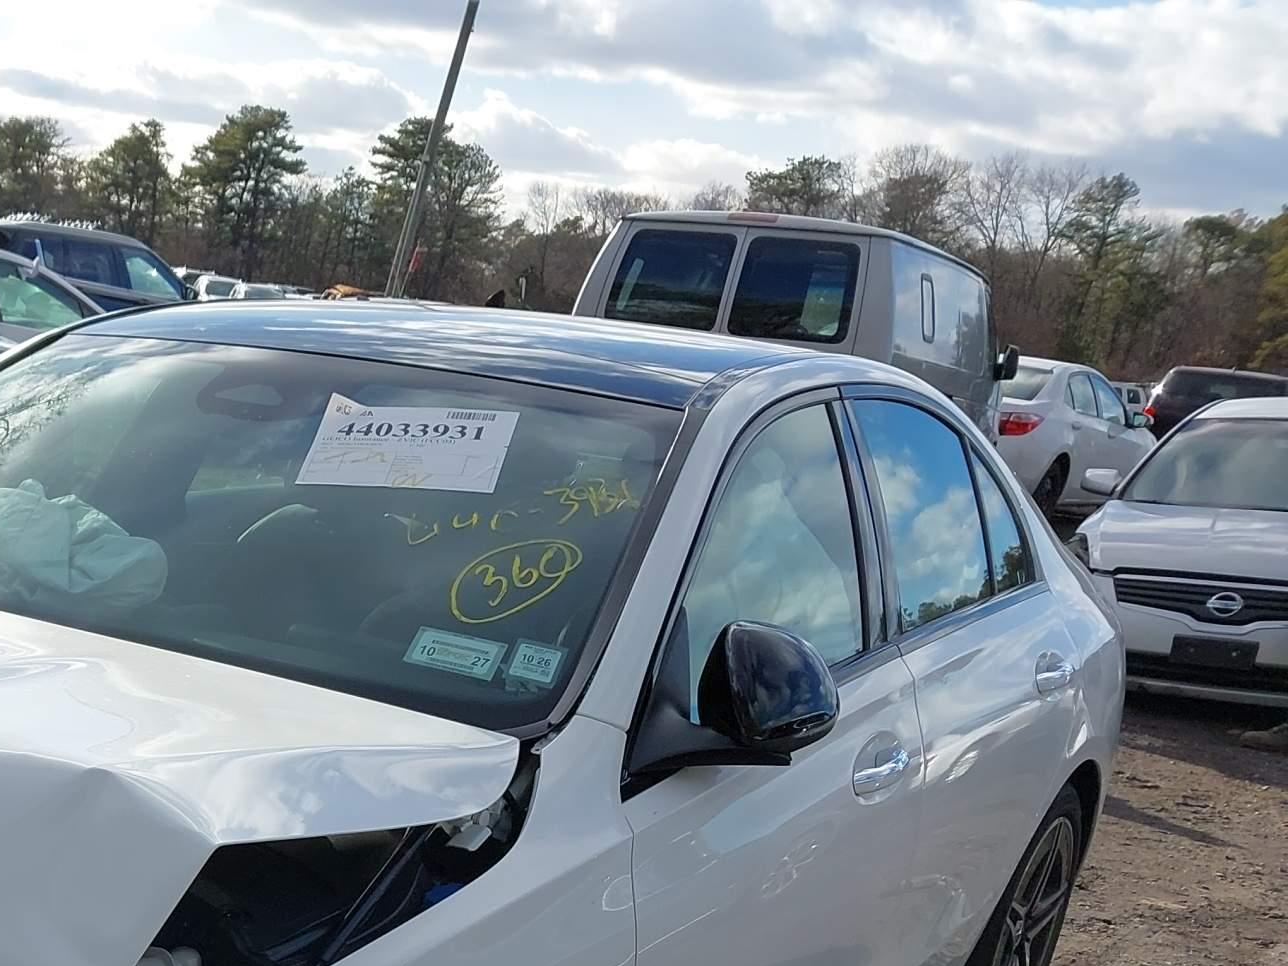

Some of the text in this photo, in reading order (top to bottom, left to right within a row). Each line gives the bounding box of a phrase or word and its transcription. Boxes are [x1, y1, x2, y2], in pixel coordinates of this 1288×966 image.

[337, 421, 487, 441] 44033931
[474, 543, 571, 608] 360
[420, 645, 436, 657] 10
[471, 656, 491, 668] 27
[522, 653, 552, 667] 10 26
